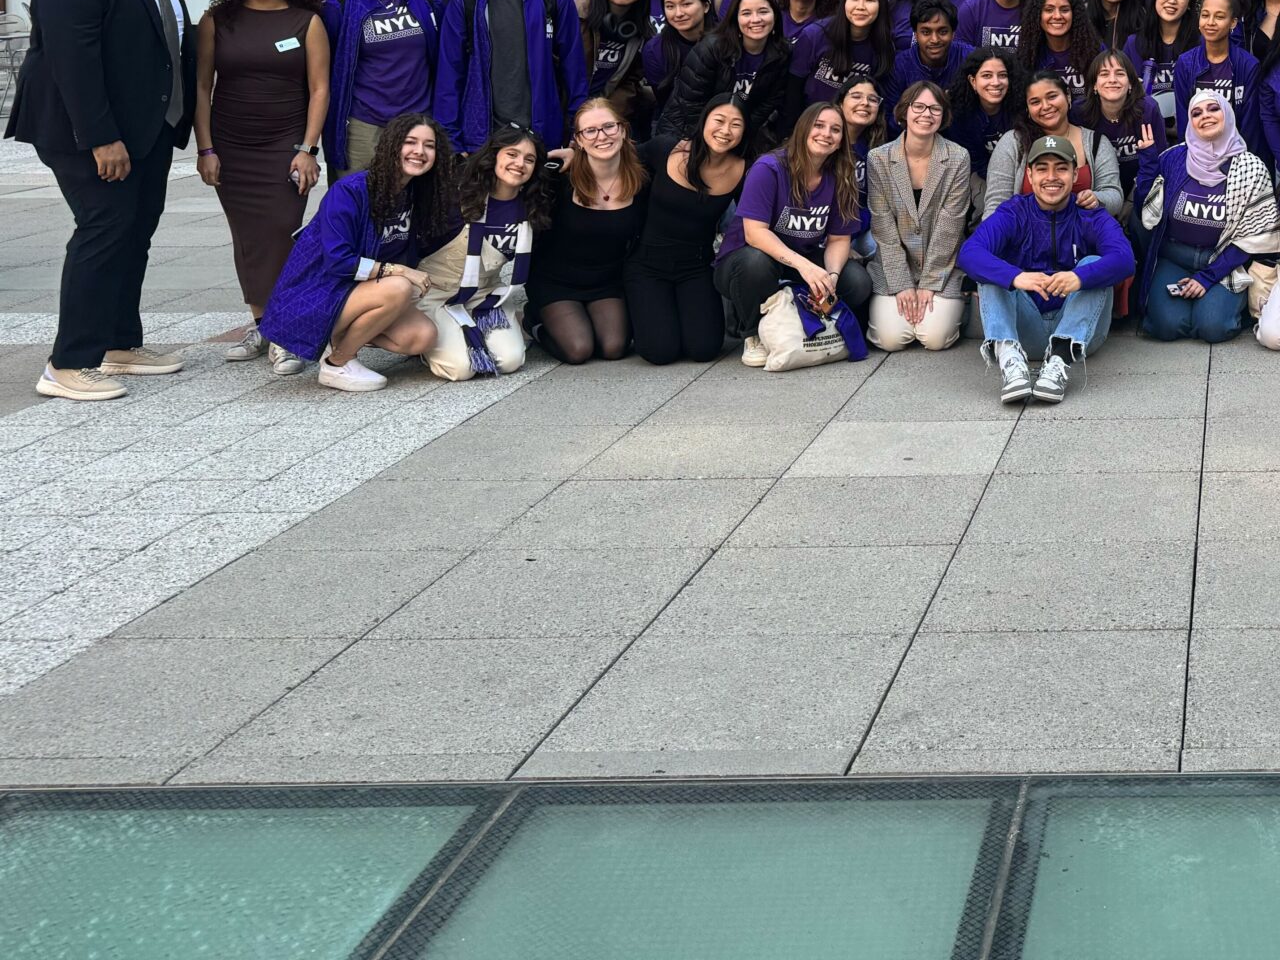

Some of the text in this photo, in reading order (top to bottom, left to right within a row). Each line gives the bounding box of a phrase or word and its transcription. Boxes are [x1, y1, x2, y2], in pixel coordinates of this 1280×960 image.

[1046, 137, 1056, 148] LA
[1184, 200, 1226, 219] NYU
[787, 214, 828, 230] NYU
